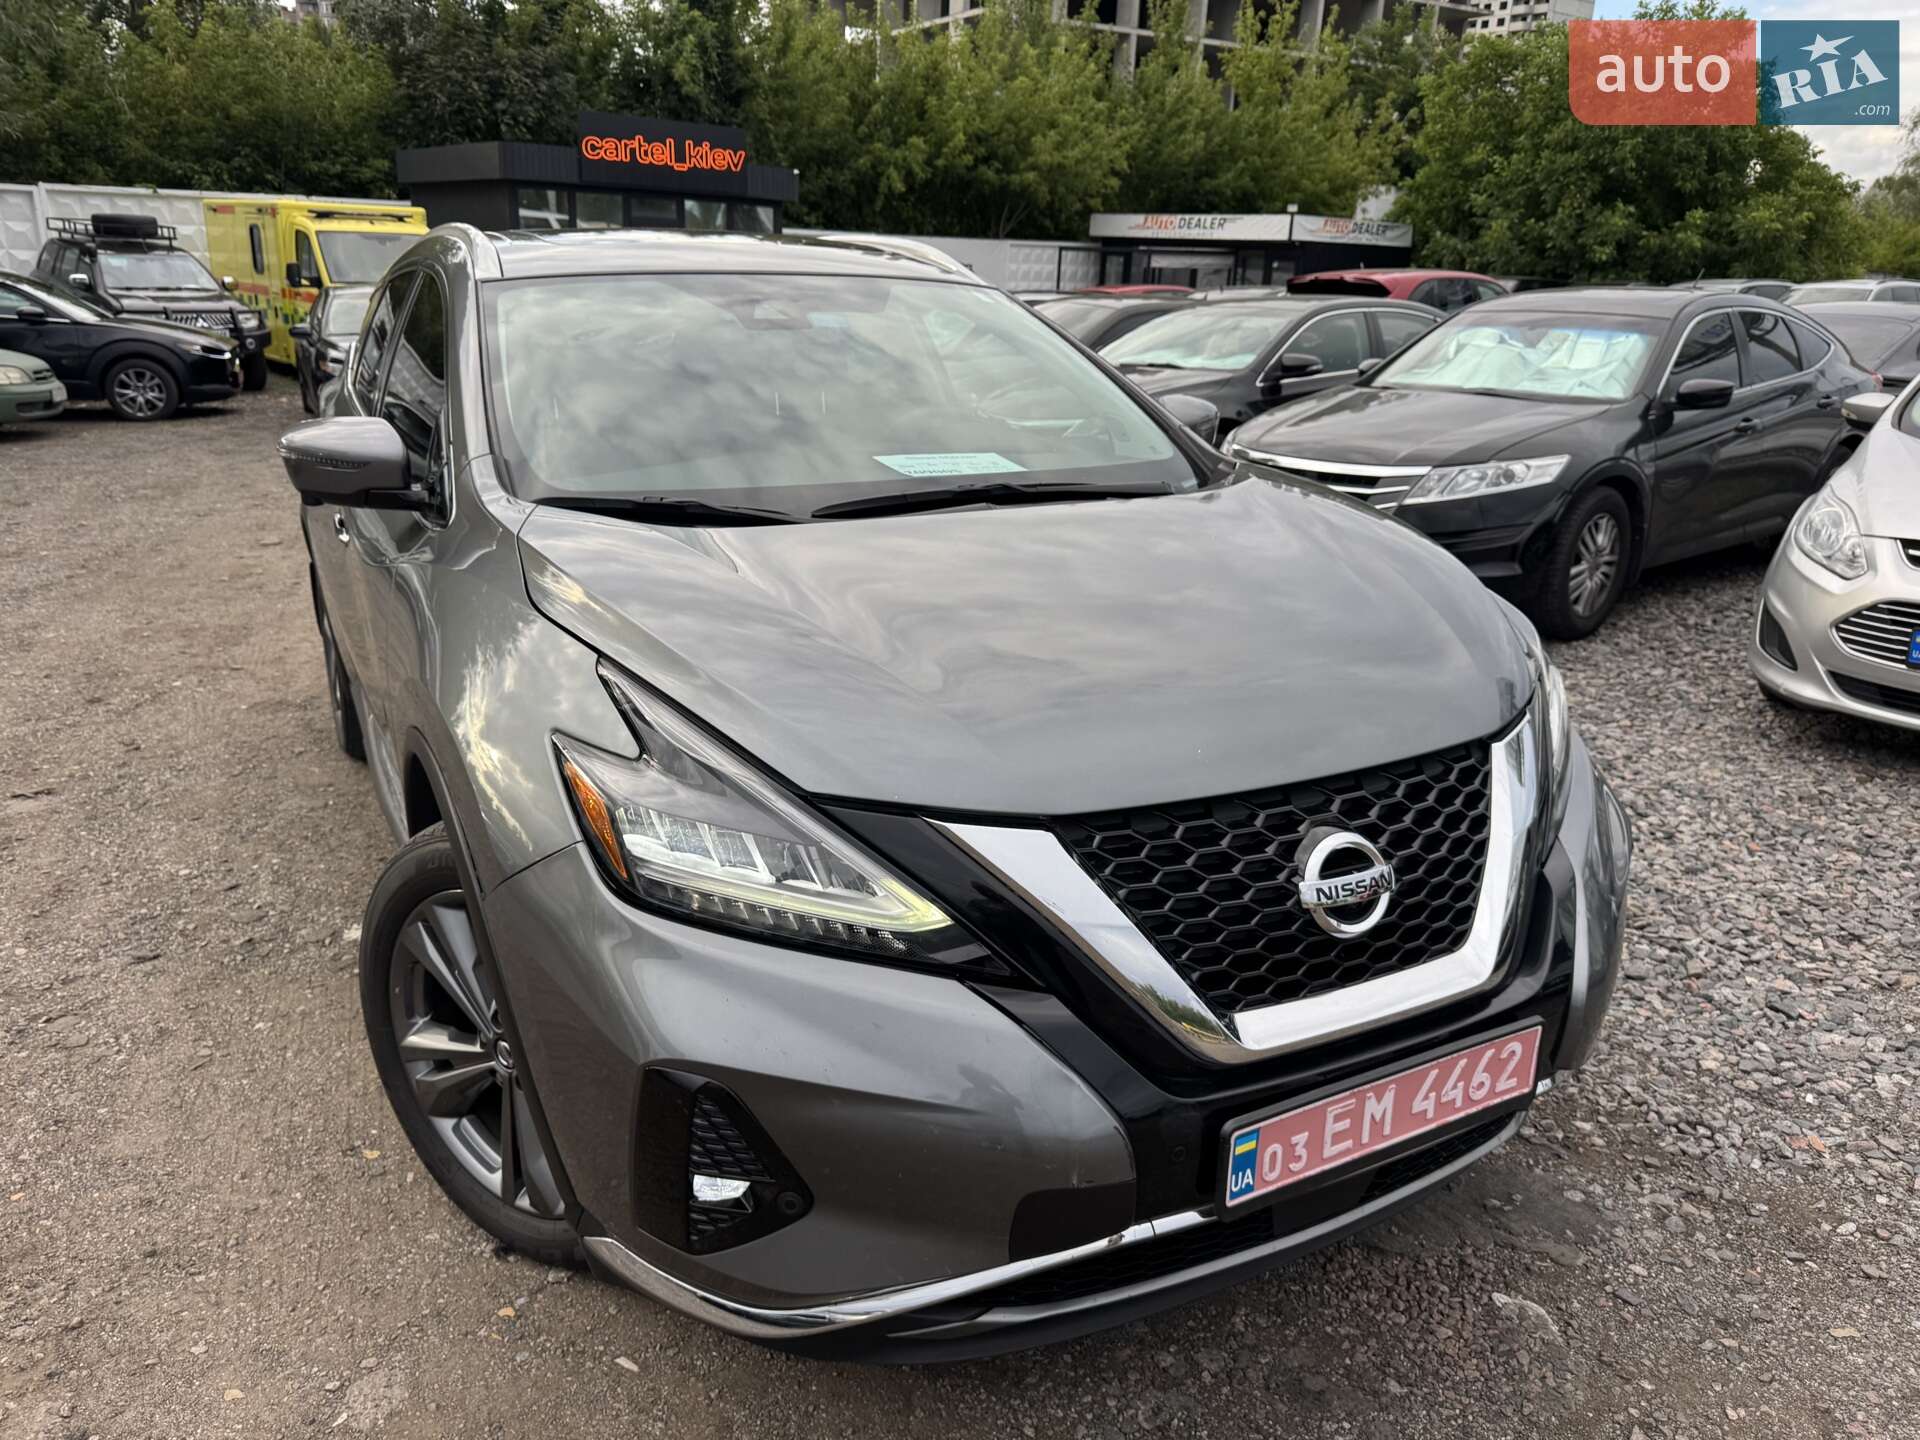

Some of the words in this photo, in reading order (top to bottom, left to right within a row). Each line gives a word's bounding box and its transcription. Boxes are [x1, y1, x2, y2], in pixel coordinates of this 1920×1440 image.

[581, 135, 746, 172] cartel_kiev
[1143, 215, 1176, 231] AUTO
[1177, 217, 1227, 230] DEALER
[1352, 221, 1389, 237] DEALER
[1315, 871, 1392, 902] NISSAN
[1261, 1131, 1309, 1182] 03
[1322, 1084, 1397, 1160] EM
[1411, 1041, 1522, 1119] 4462
[1231, 1168, 1253, 1192] UA
